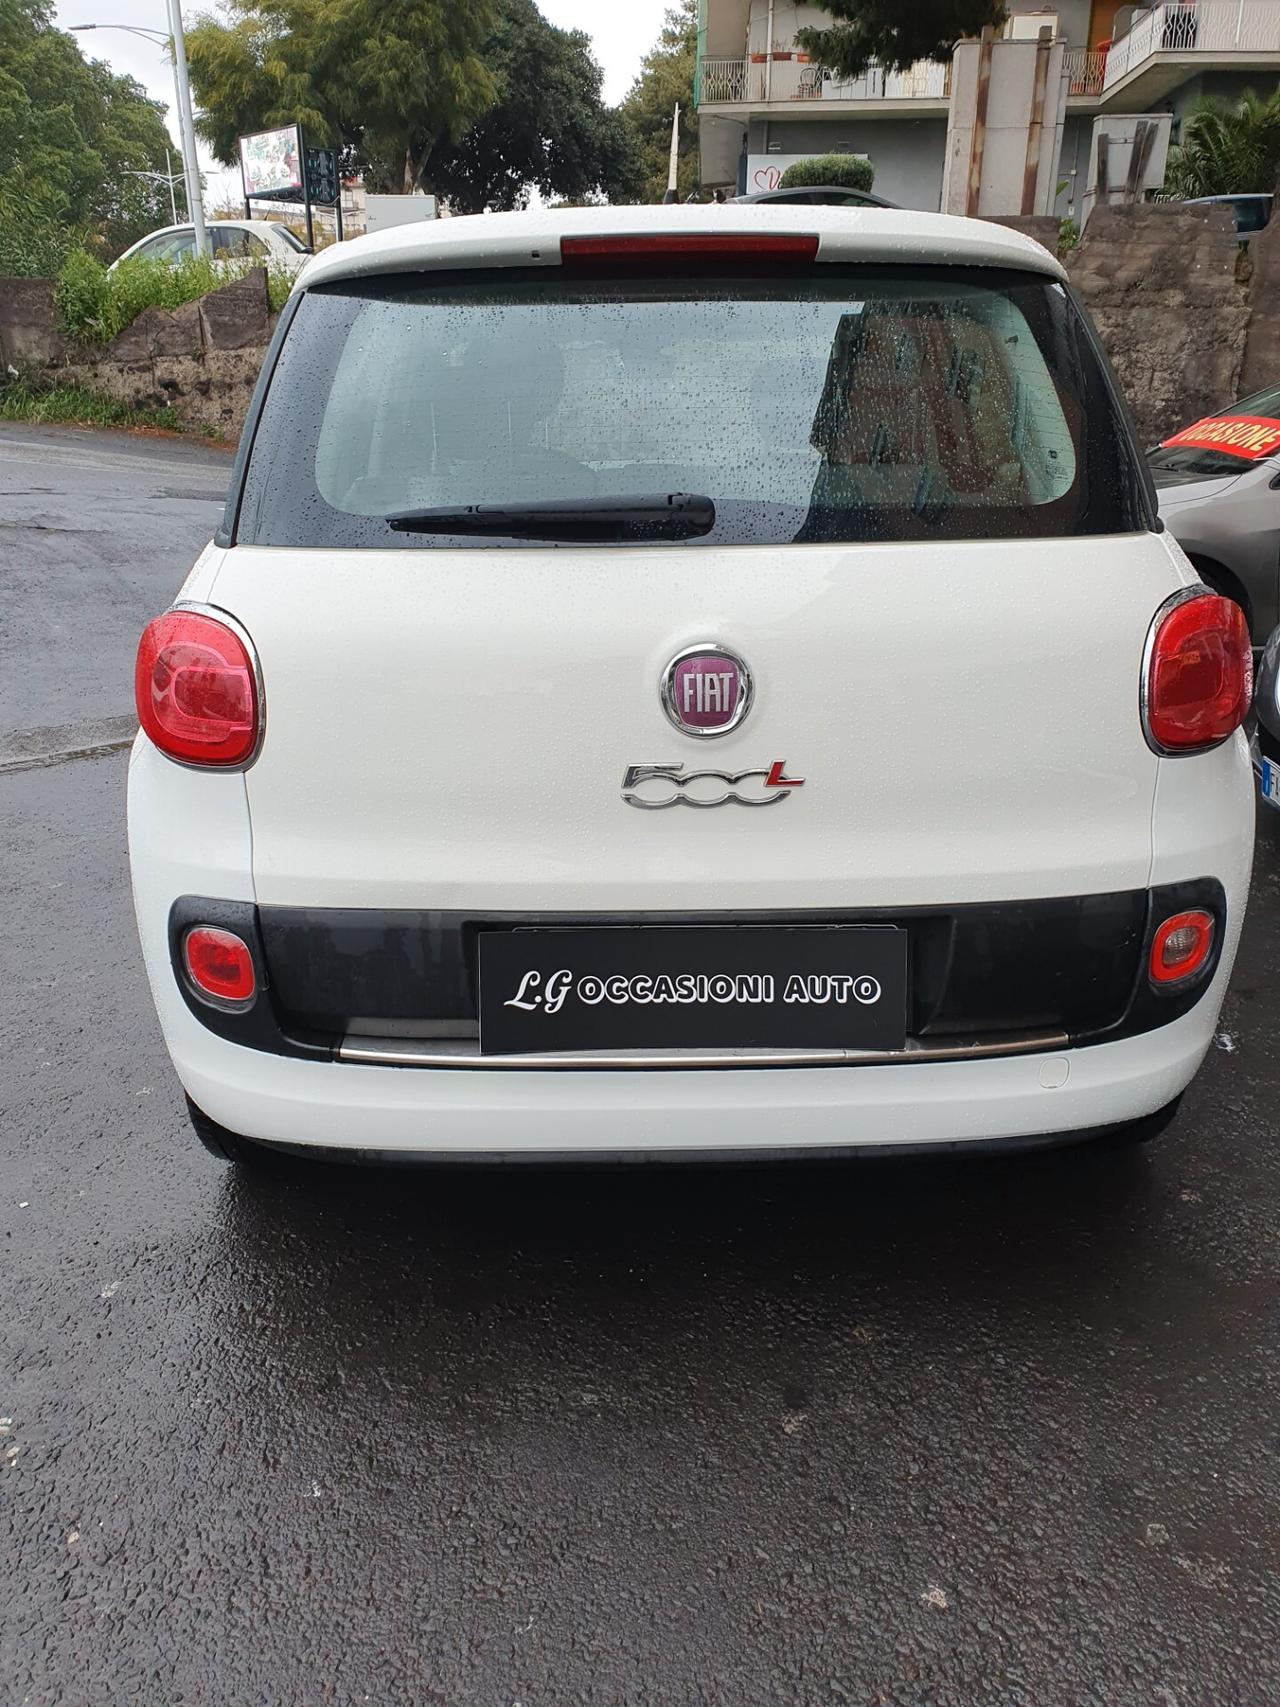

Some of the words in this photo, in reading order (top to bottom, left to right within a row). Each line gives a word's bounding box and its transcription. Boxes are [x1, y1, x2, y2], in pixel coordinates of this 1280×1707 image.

[683, 673, 734, 713] FIAT
[620, 760, 806, 810] 500L
[577, 975, 775, 1004] OCCASIONI
[783, 975, 881, 1005] AUTO
